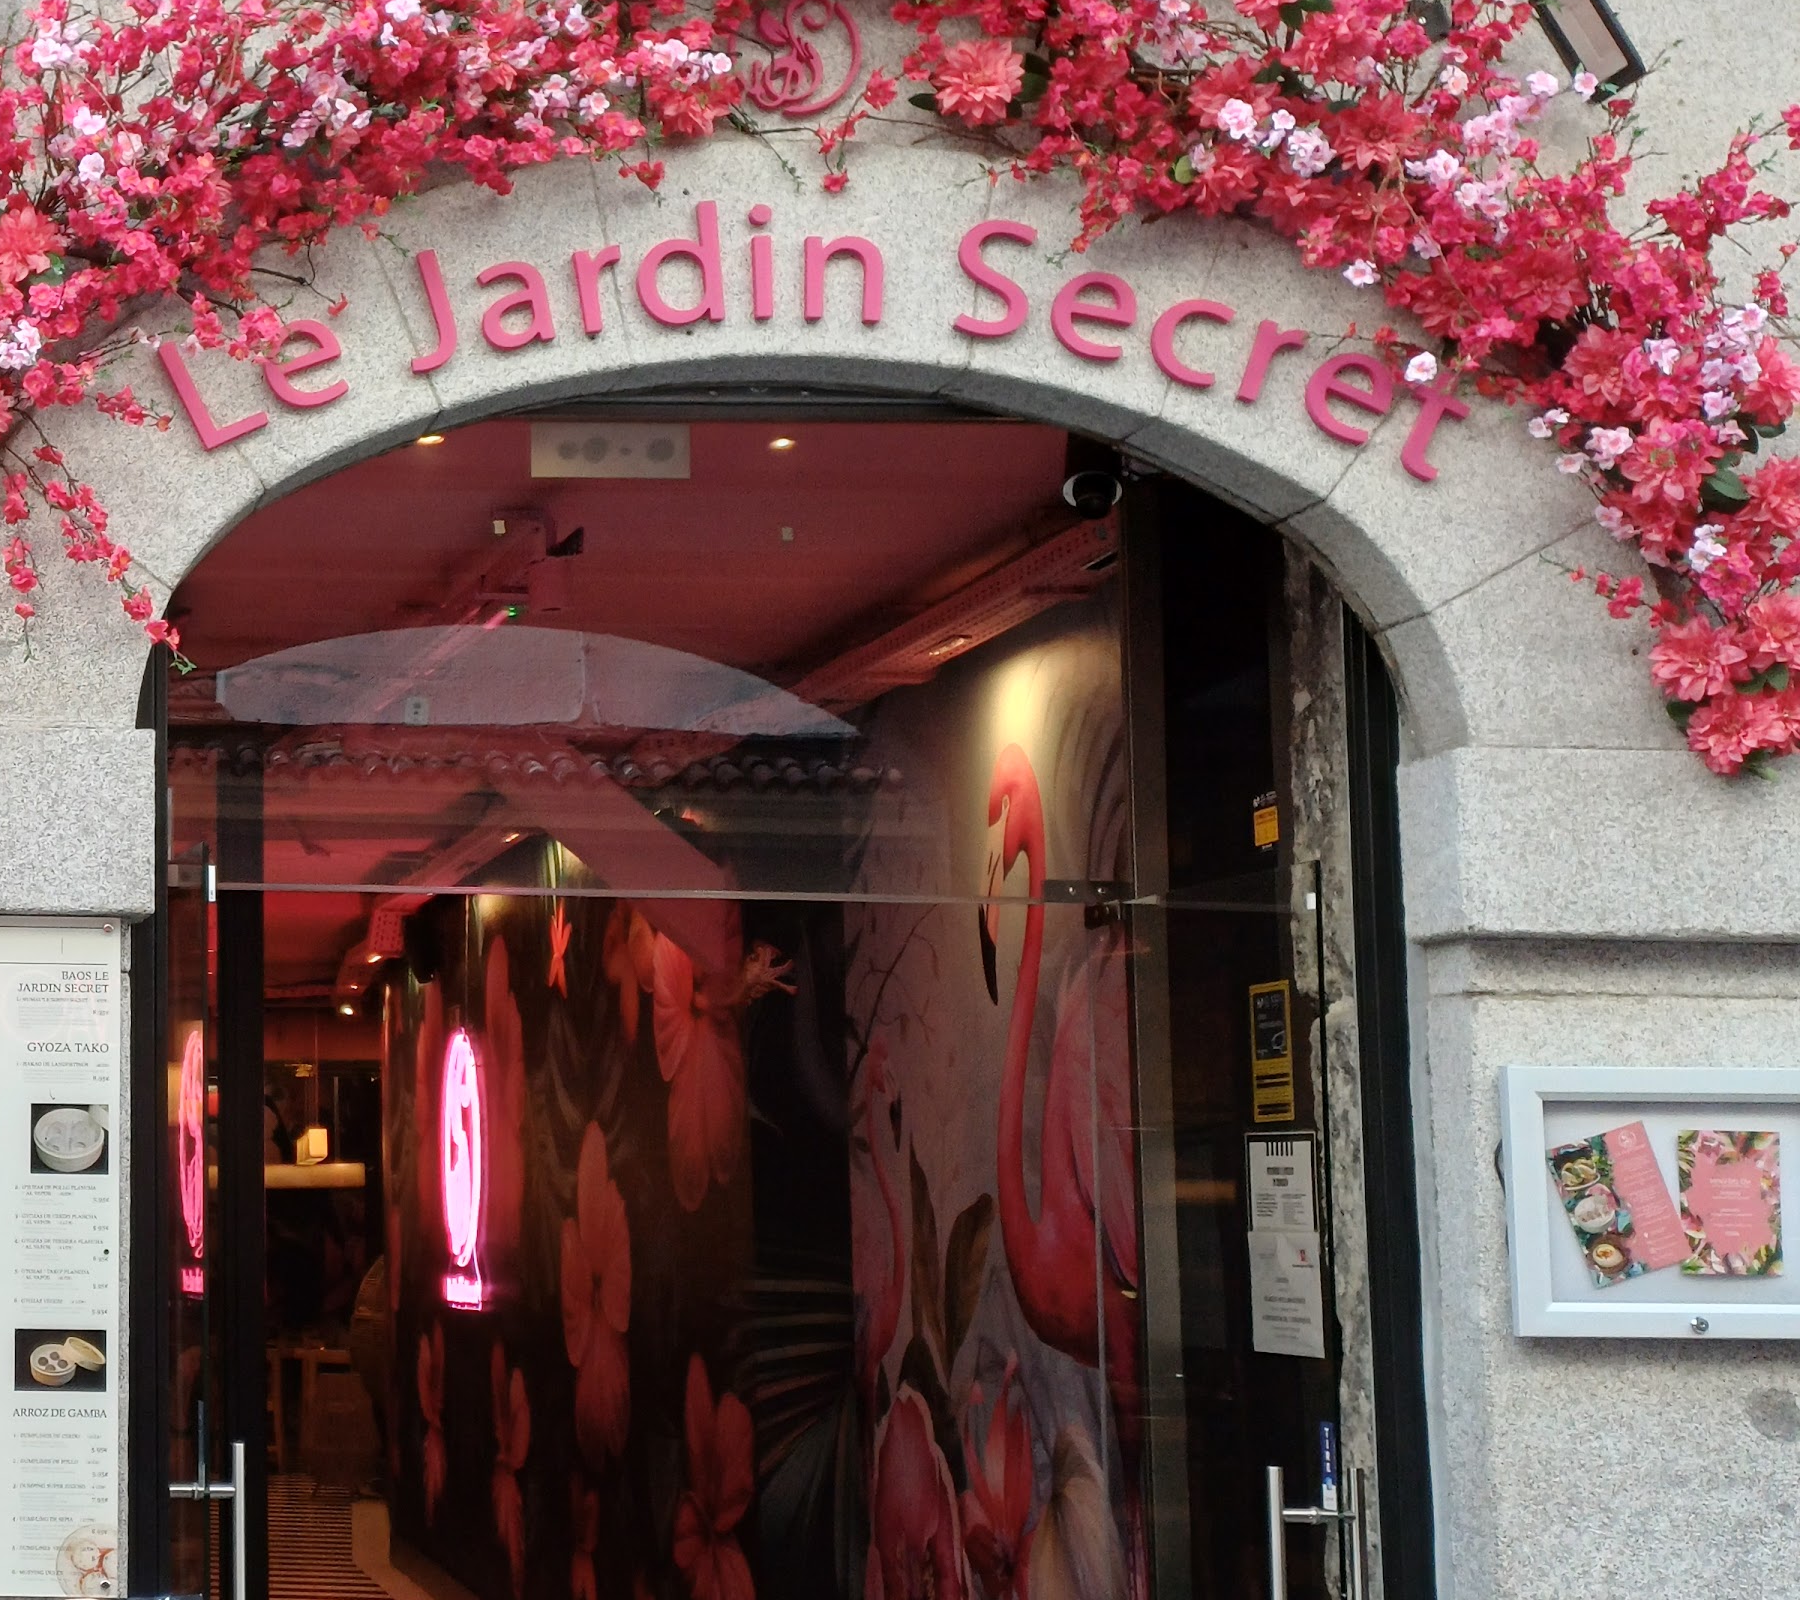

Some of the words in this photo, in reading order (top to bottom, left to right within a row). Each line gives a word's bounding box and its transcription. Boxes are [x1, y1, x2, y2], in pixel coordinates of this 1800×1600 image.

[156, 313, 351, 451] Le
[408, 199, 886, 376] Jardin
[952, 217, 1474, 485] Secret
[61, 970, 92, 981] BAOS
[95, 971, 109, 981] LE
[17, 982, 61, 993] JARDIN
[64, 983, 109, 994] SECRET
[26, 1042, 71, 1053] GYOZA
[75, 1042, 109, 1053] TAKO
[12, 1407, 49, 1418] ARROZ
[50, 1408, 66, 1418] DE
[67, 1408, 108, 1419] GAMBA
